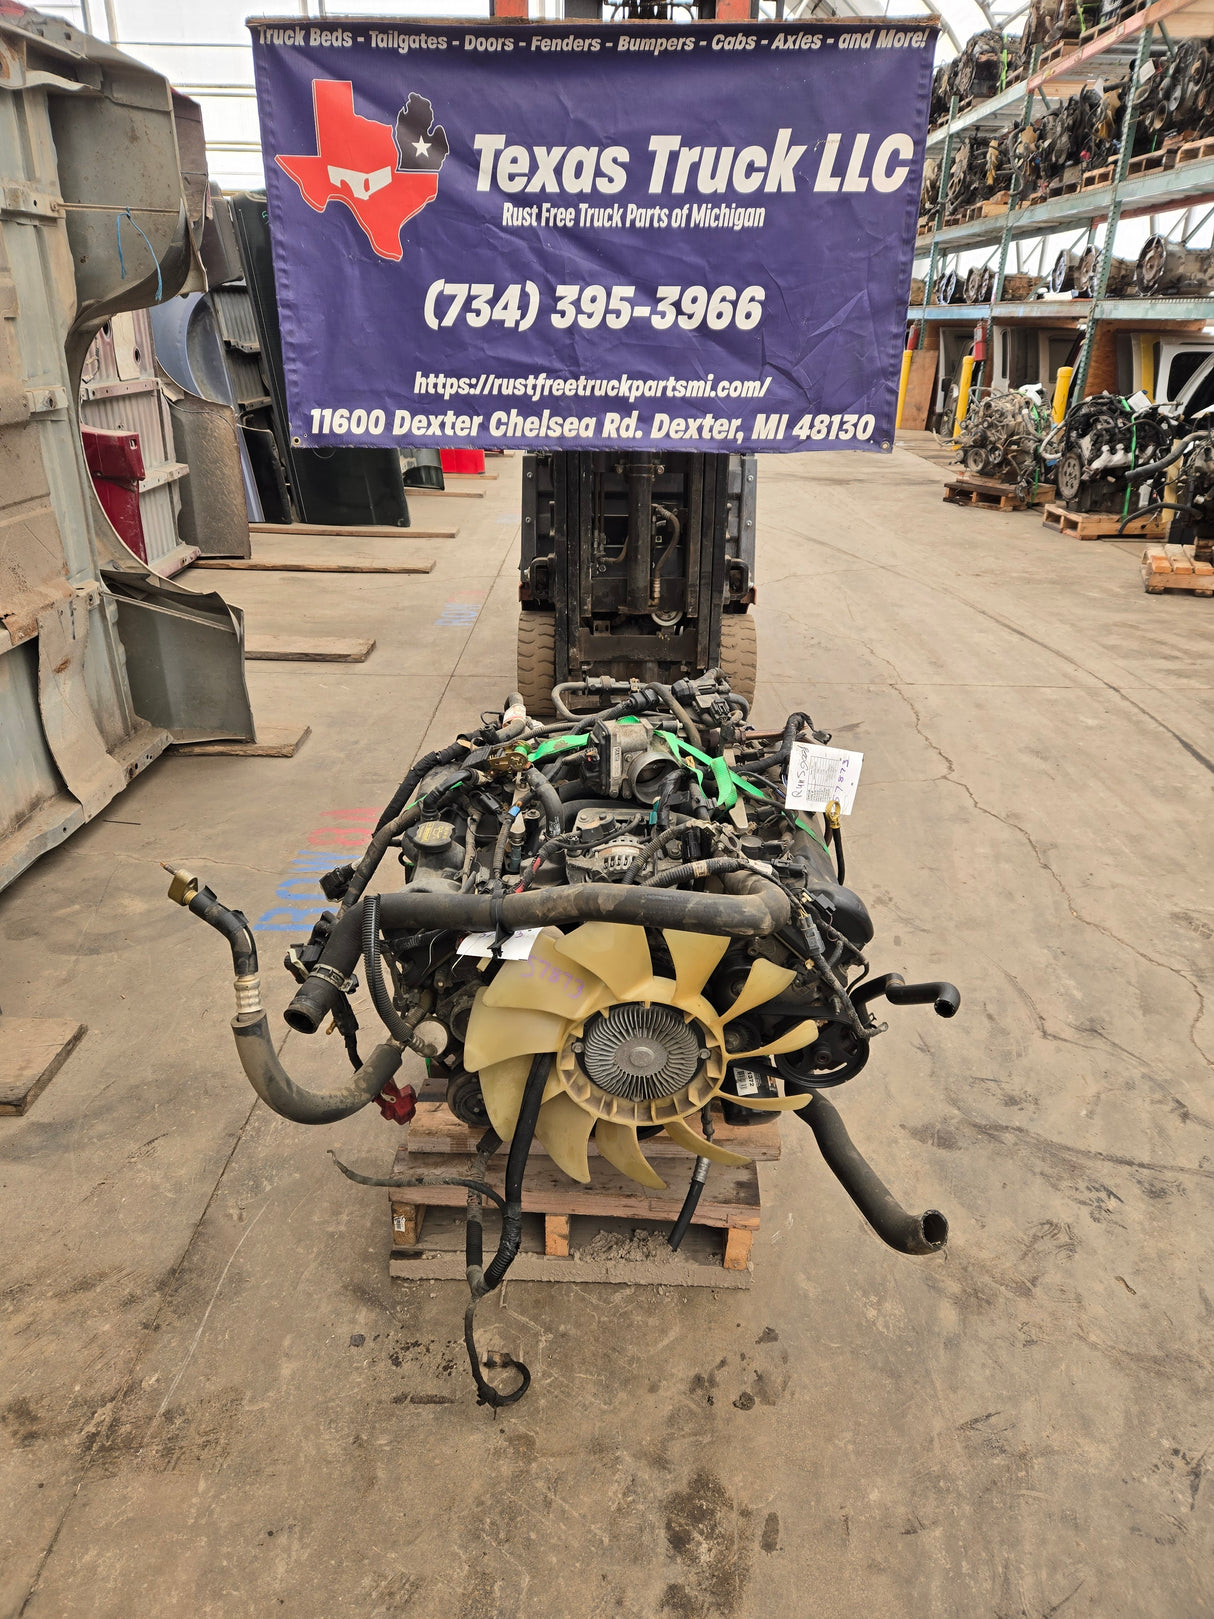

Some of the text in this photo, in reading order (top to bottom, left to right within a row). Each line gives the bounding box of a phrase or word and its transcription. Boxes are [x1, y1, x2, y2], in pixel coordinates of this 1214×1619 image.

[259, 26, 305, 47] Truck
[309, 28, 353, 48] Beds
[369, 30, 448, 54] Tailgates
[464, 34, 515, 52] Doors
[530, 34, 602, 52] Fenders
[617, 35, 695, 56] Bumpers
[711, 32, 757, 51] Cabs
[770, 31, 823, 50] Axles
[838, 30, 872, 49] and
[875, 28, 930, 49] More!
[473, 127, 915, 194] Texas Truck LLC
[502, 202, 766, 231] Rust Free Truck Parts of Michigan
[423, 278, 766, 332] (734) 395-3966
[413, 371, 773, 401] https://rustfreetruckpartsmi.com/
[310, 408, 876, 444] 11600 Dexter Chelsea Rd. Dexter, MI 48130
[520, 953, 585, 1000] 57873
